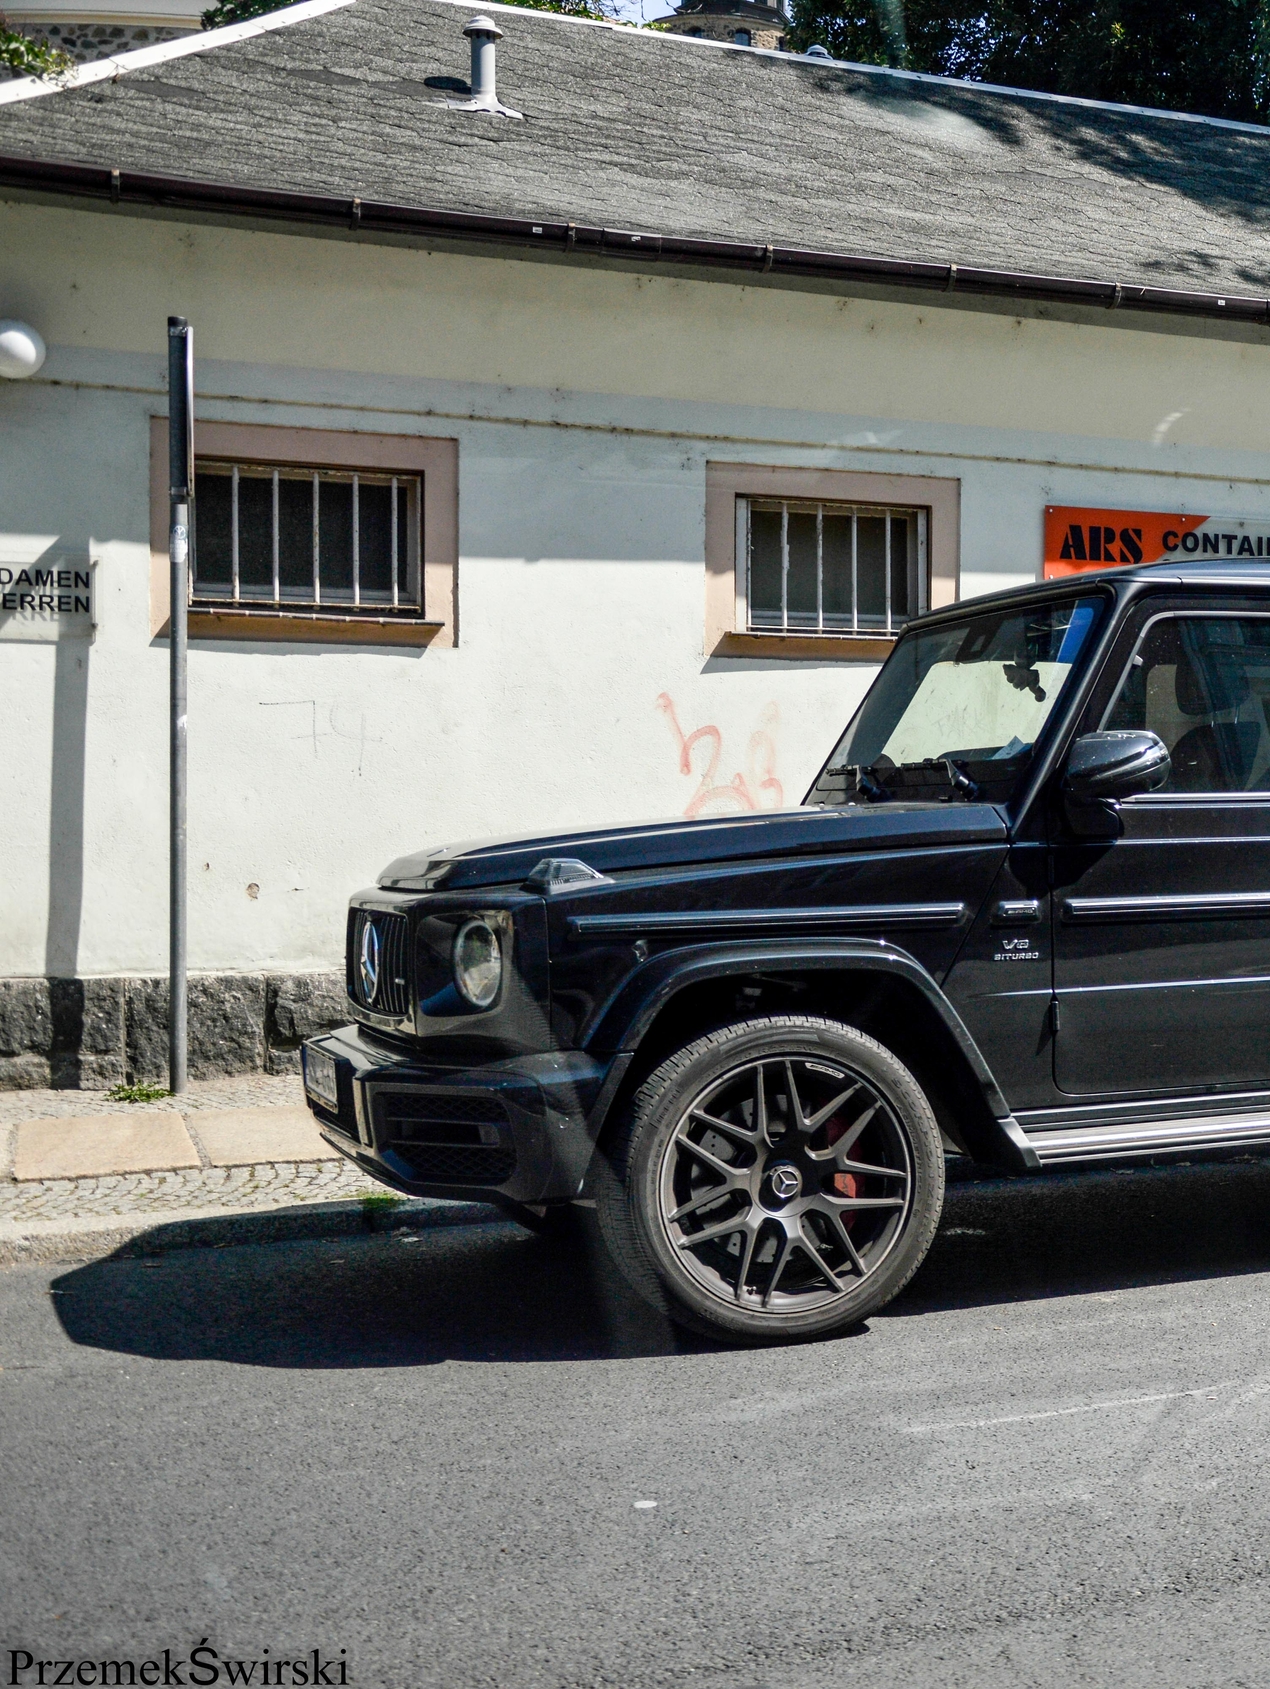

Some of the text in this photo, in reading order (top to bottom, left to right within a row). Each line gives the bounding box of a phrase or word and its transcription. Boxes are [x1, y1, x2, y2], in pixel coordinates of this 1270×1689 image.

[1060, 524, 1143, 564] ARS
[0, 567, 90, 589] DAMEN
[1002, 939, 1029, 950] V8
[993, 951, 1039, 961] BITURBO
